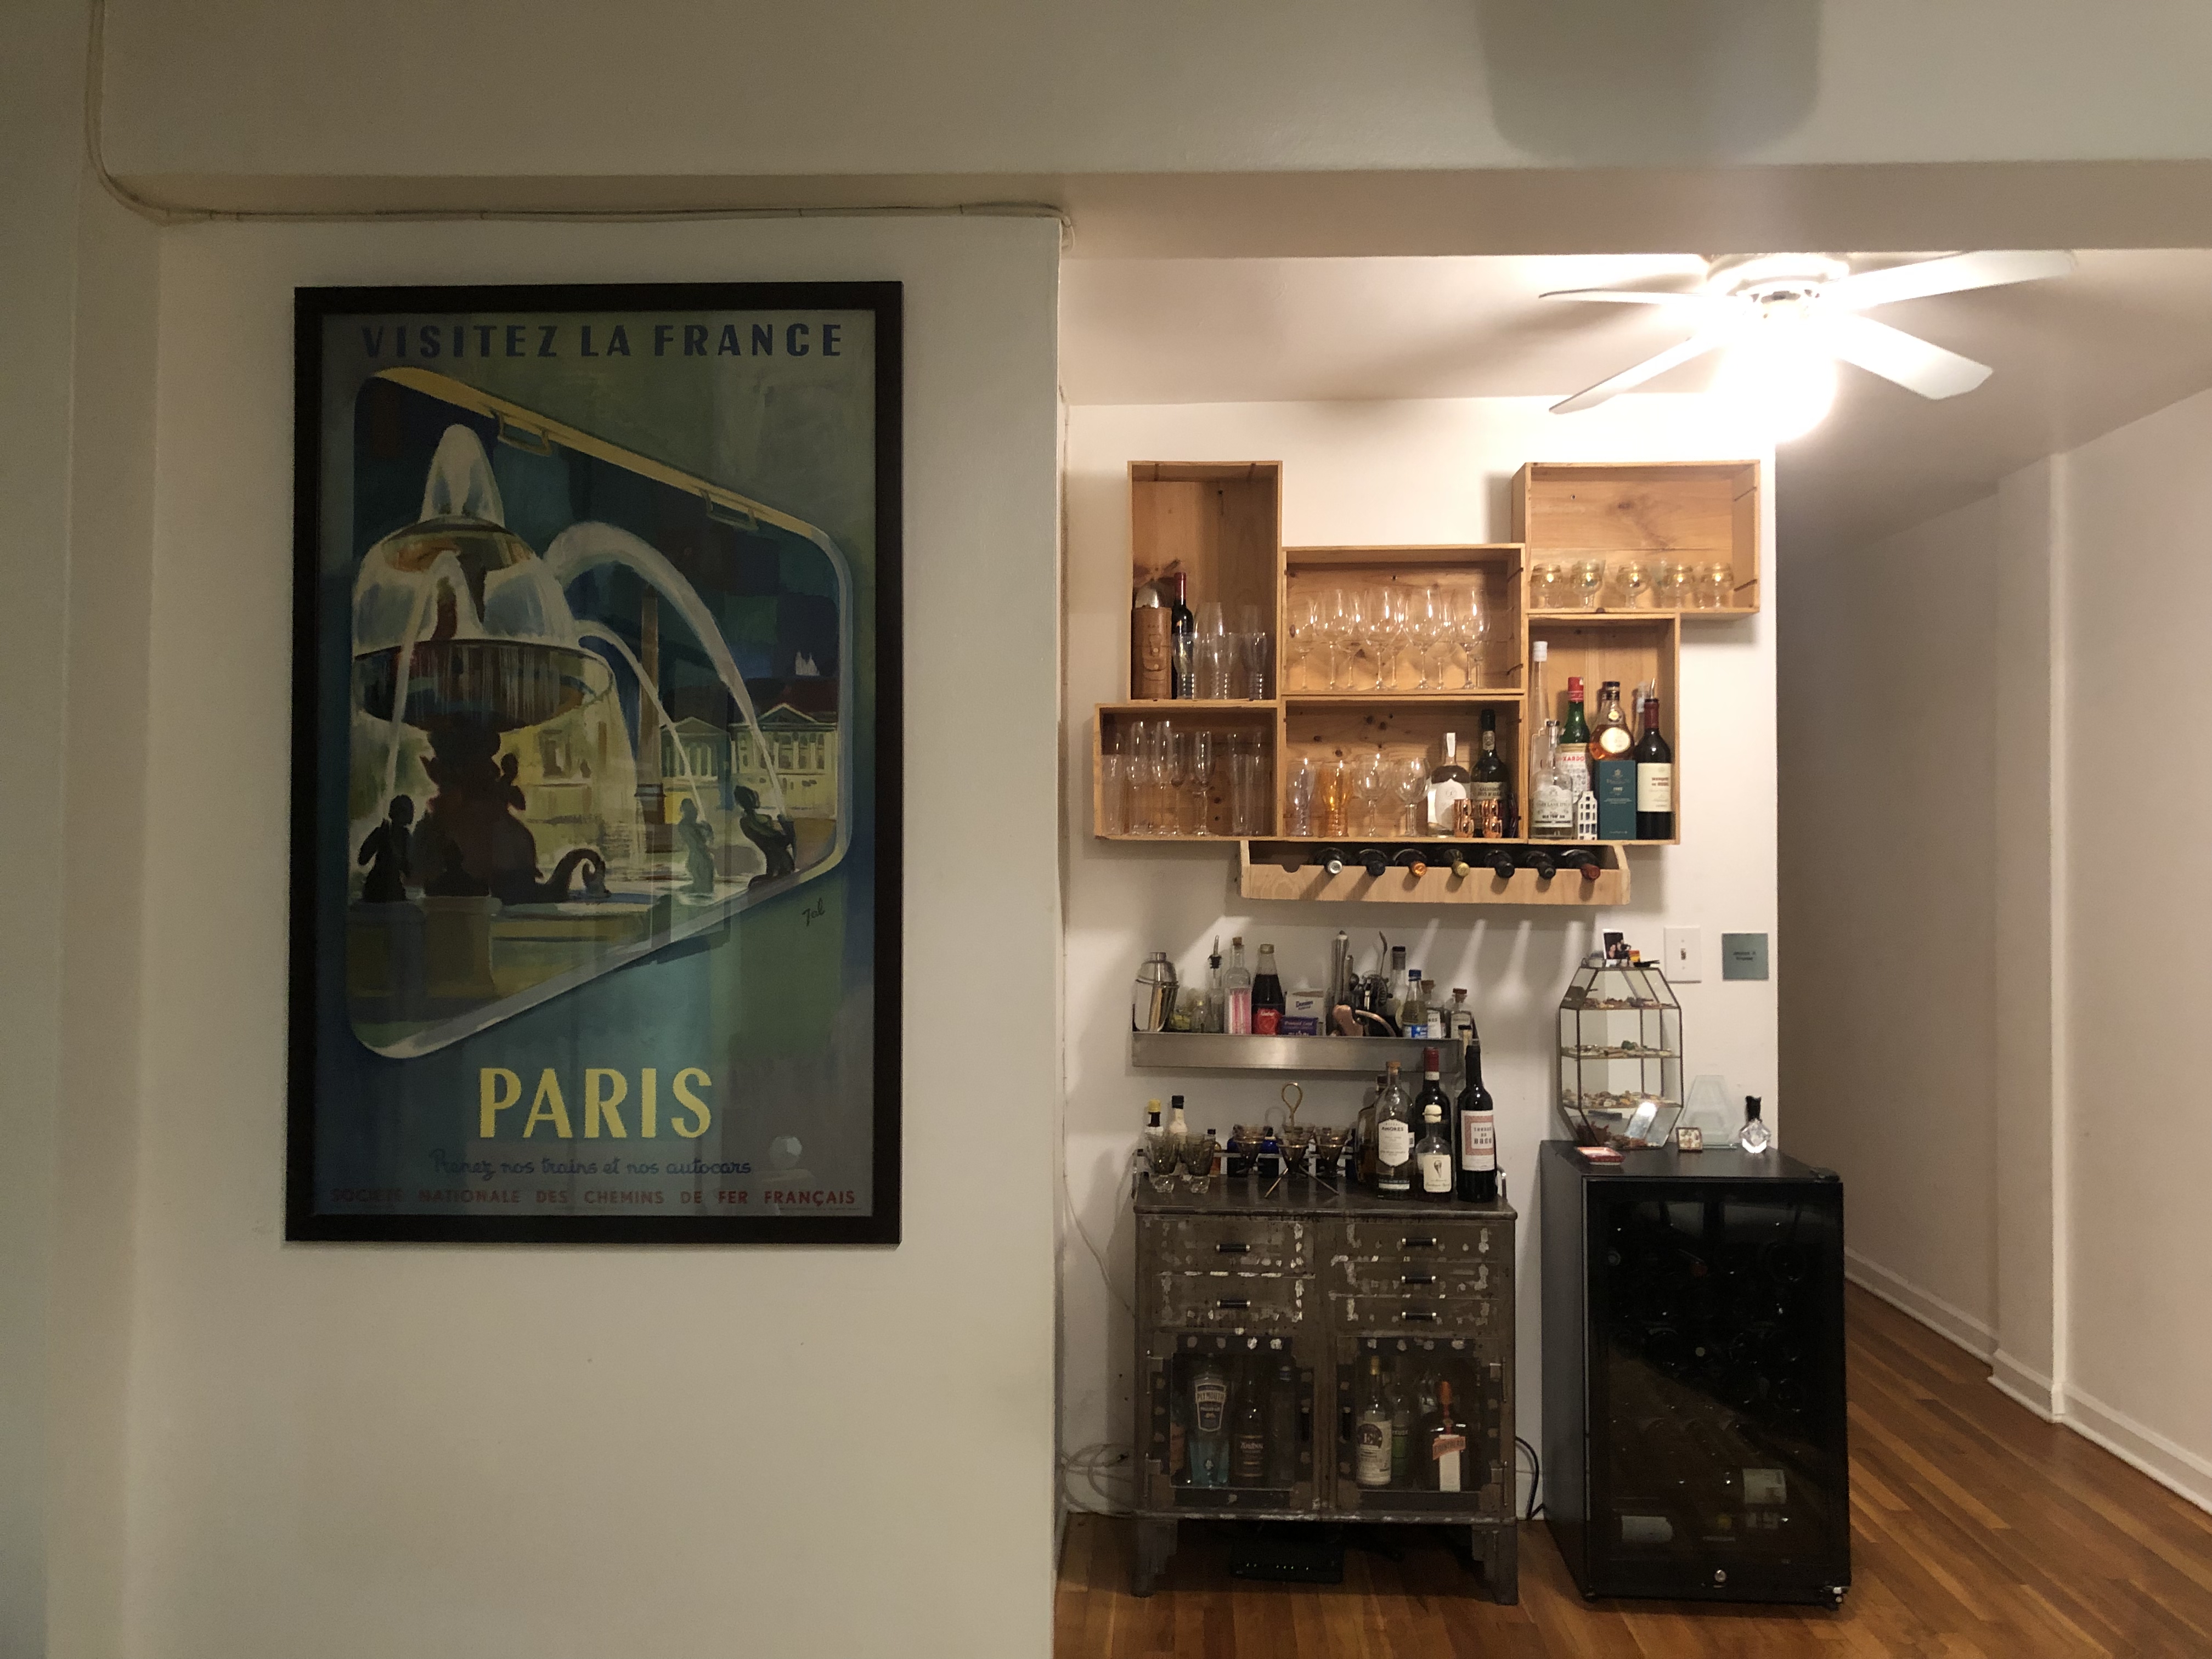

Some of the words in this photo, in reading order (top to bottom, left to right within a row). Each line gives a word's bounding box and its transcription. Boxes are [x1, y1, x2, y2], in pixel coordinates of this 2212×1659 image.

[362, 325, 557, 358] VISITEZ
[580, 324, 631, 357] LA
[654, 323, 841, 357] FRANCE
[478, 1067, 713, 1138] PARIS
[500, 1161, 535, 1174] nos
[541, 1158, 597, 1175] trains
[602, 1158, 620, 1175] et
[627, 1161, 659, 1175] nos
[665, 1158, 752, 1175] autocars
[417, 1189, 521, 1203] NATIONALE
[535, 1190, 569, 1204] DES
[584, 1190, 665, 1204] CHEMINS
[680, 1190, 703, 1204] DE
[718, 1190, 748, 1204] FER
[764, 1190, 856, 1207] FRANÇAIS
[1197, 1391, 1224, 1402] PLYMOUTH
